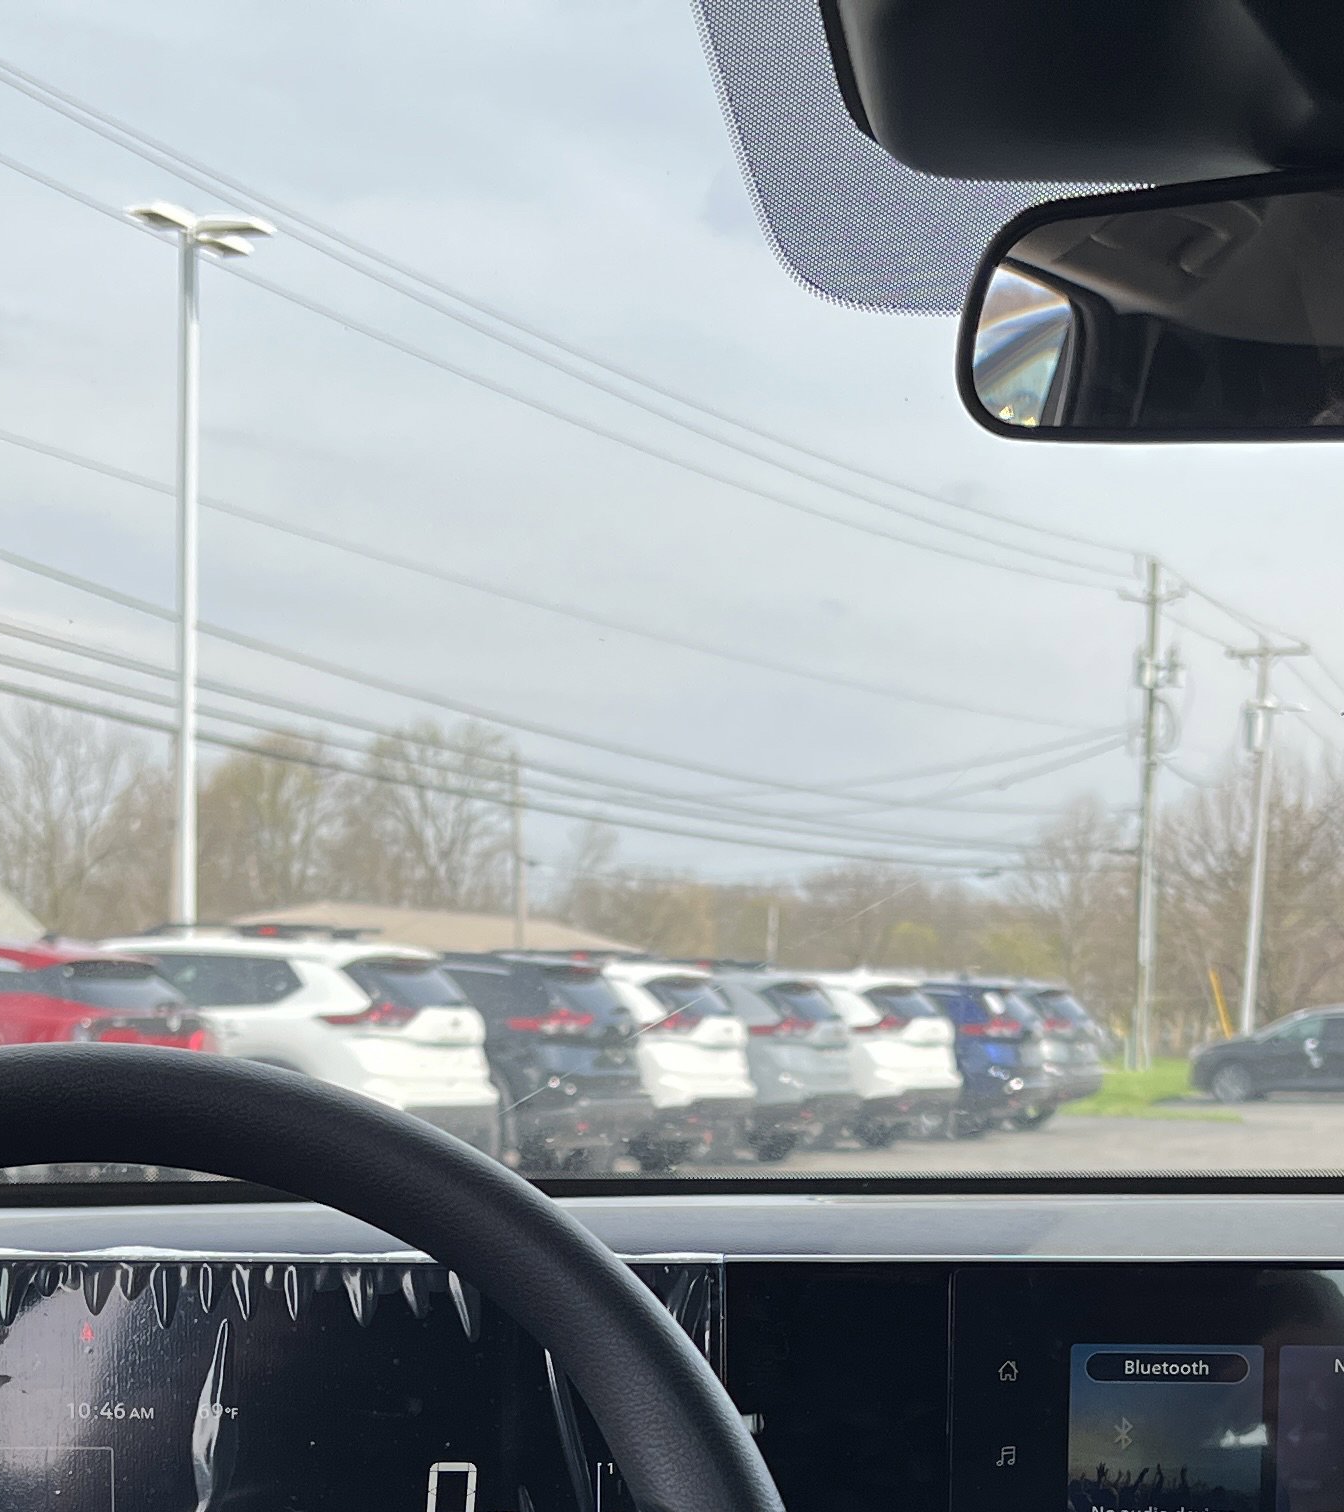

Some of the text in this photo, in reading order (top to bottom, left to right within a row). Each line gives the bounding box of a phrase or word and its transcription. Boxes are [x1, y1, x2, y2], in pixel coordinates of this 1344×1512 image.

[1123, 1357, 1210, 1377] Bluetooth
[67, 1401, 126, 1420] 10:46
[129, 1407, 155, 1420] AM
[606, 1462, 614, 1474] 1
